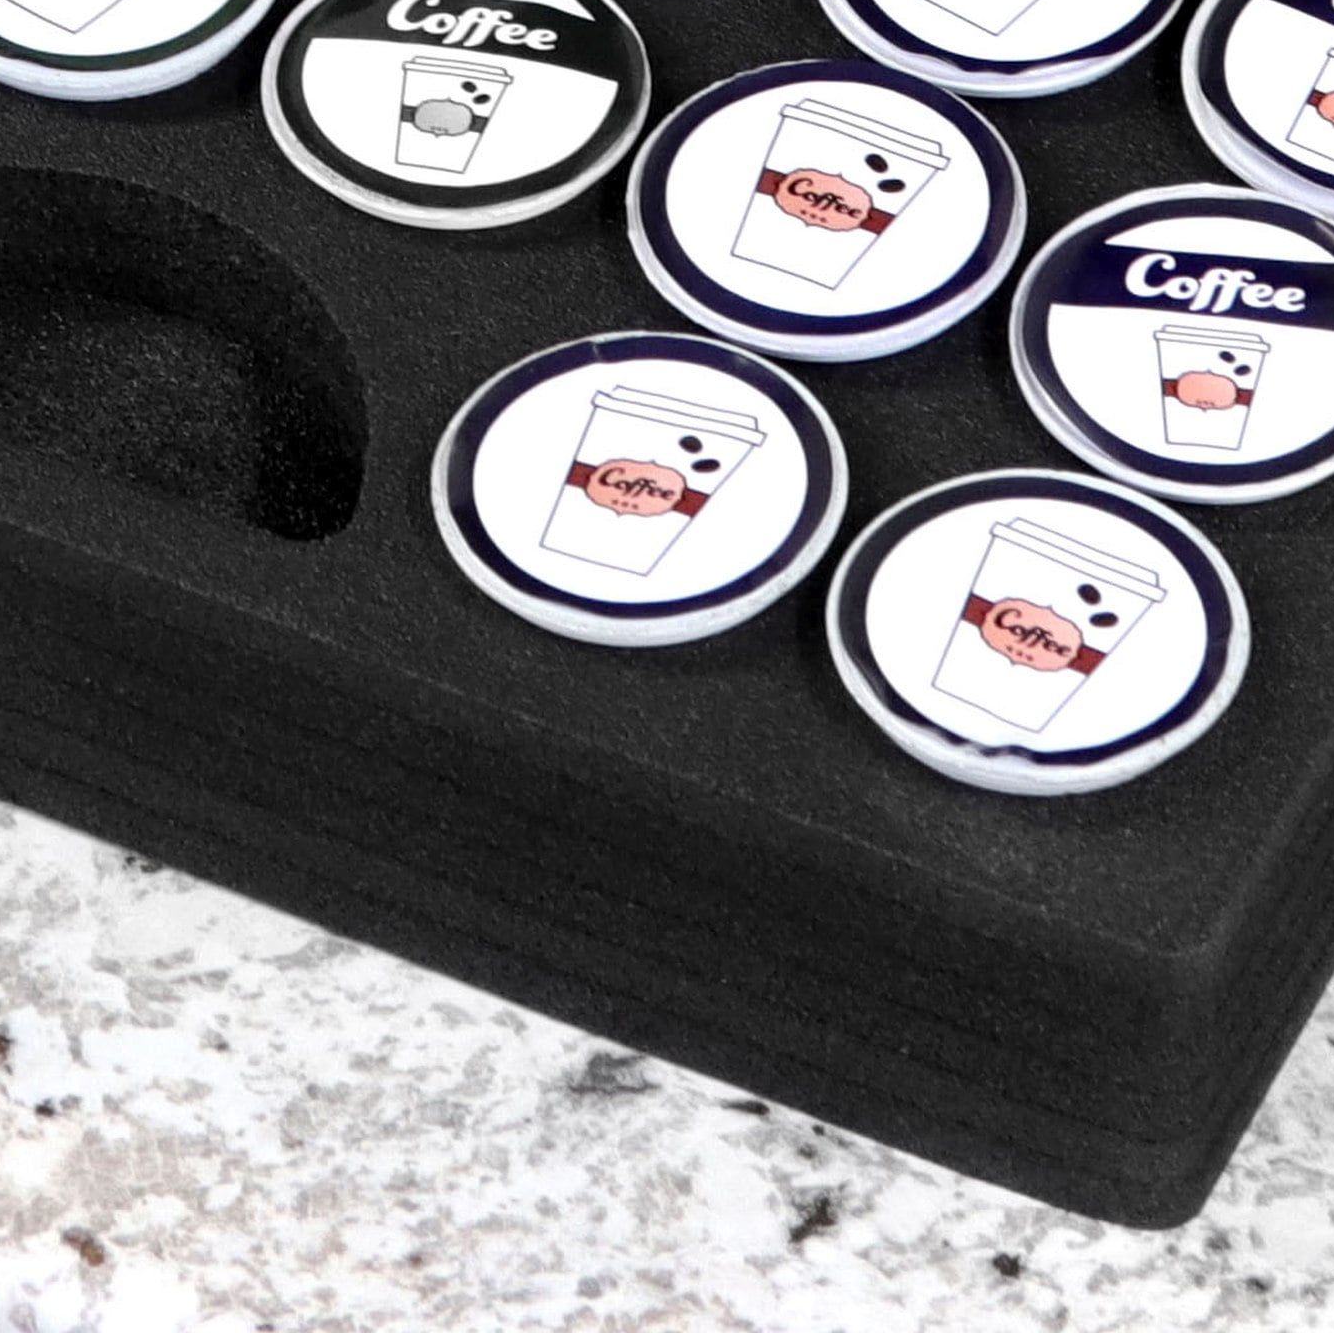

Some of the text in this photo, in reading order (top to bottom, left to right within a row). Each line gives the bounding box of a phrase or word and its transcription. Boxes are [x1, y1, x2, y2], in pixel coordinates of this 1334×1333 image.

[787, 177, 861, 218] Coffee
[1125, 253, 1305, 314] Coffee
[598, 468, 674, 499] Coffee
[994, 609, 1069, 655] Coffee
